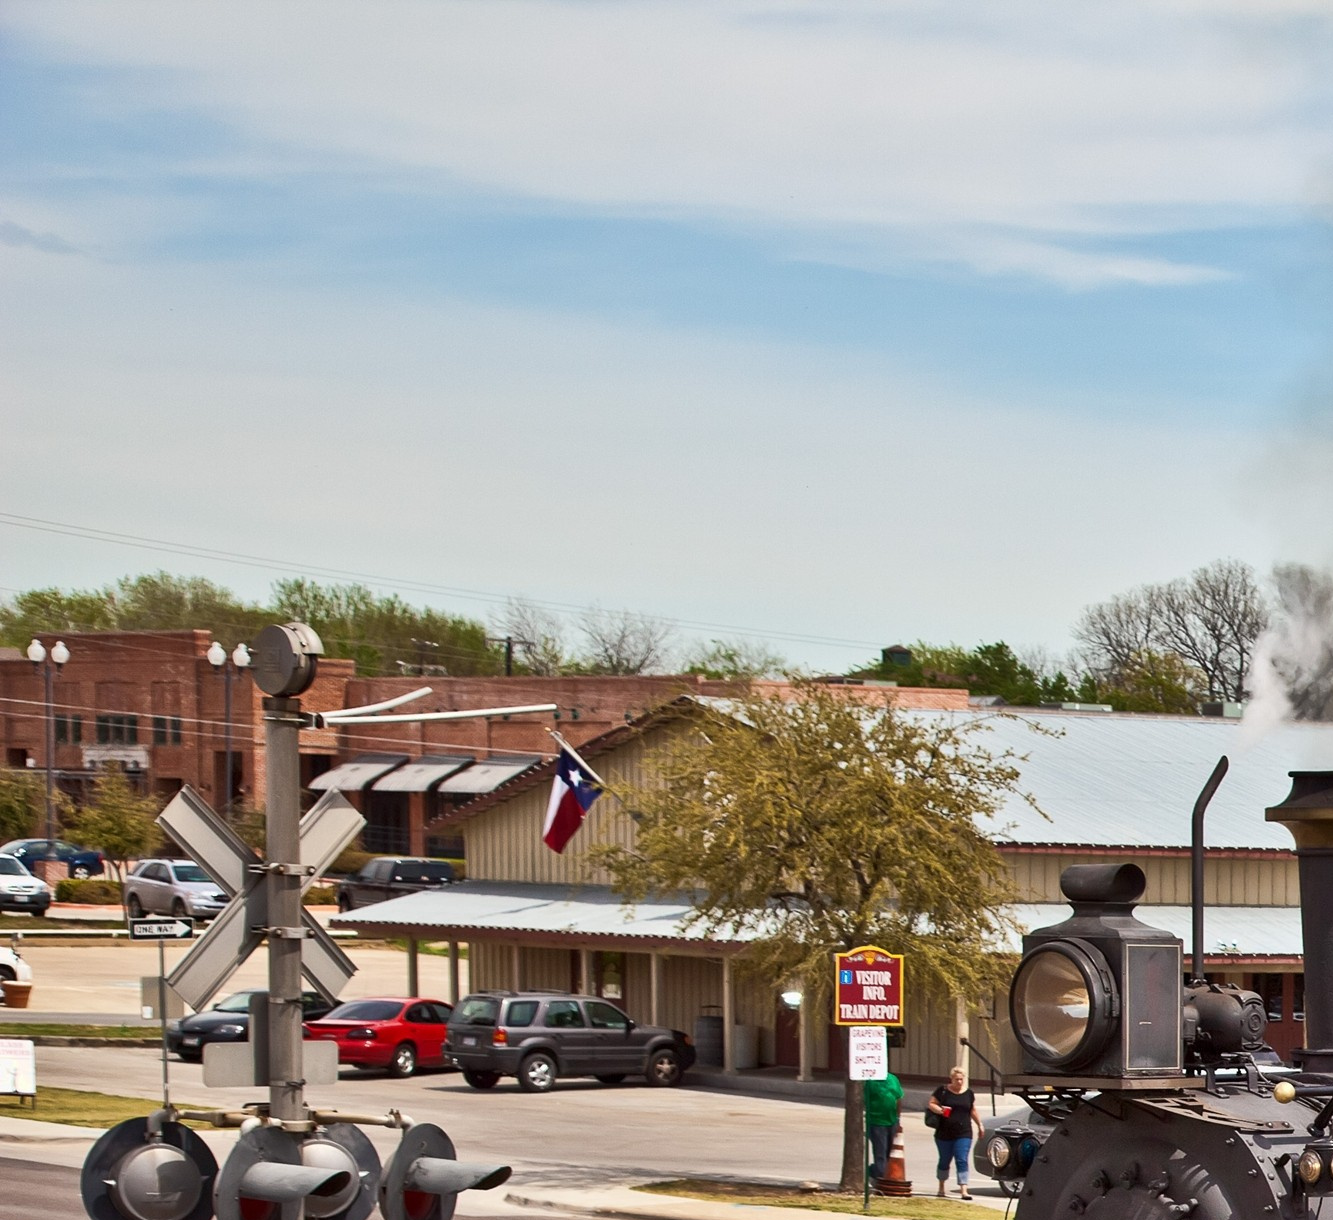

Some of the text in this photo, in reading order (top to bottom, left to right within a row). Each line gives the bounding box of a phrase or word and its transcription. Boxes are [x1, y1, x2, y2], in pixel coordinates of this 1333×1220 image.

[135, 925, 174, 934] ONE WAY
[855, 970, 892, 986] VISITOR
[862, 986, 887, 1001] INFO.
[840, 1004, 900, 1020] TRAIN DEPOT
